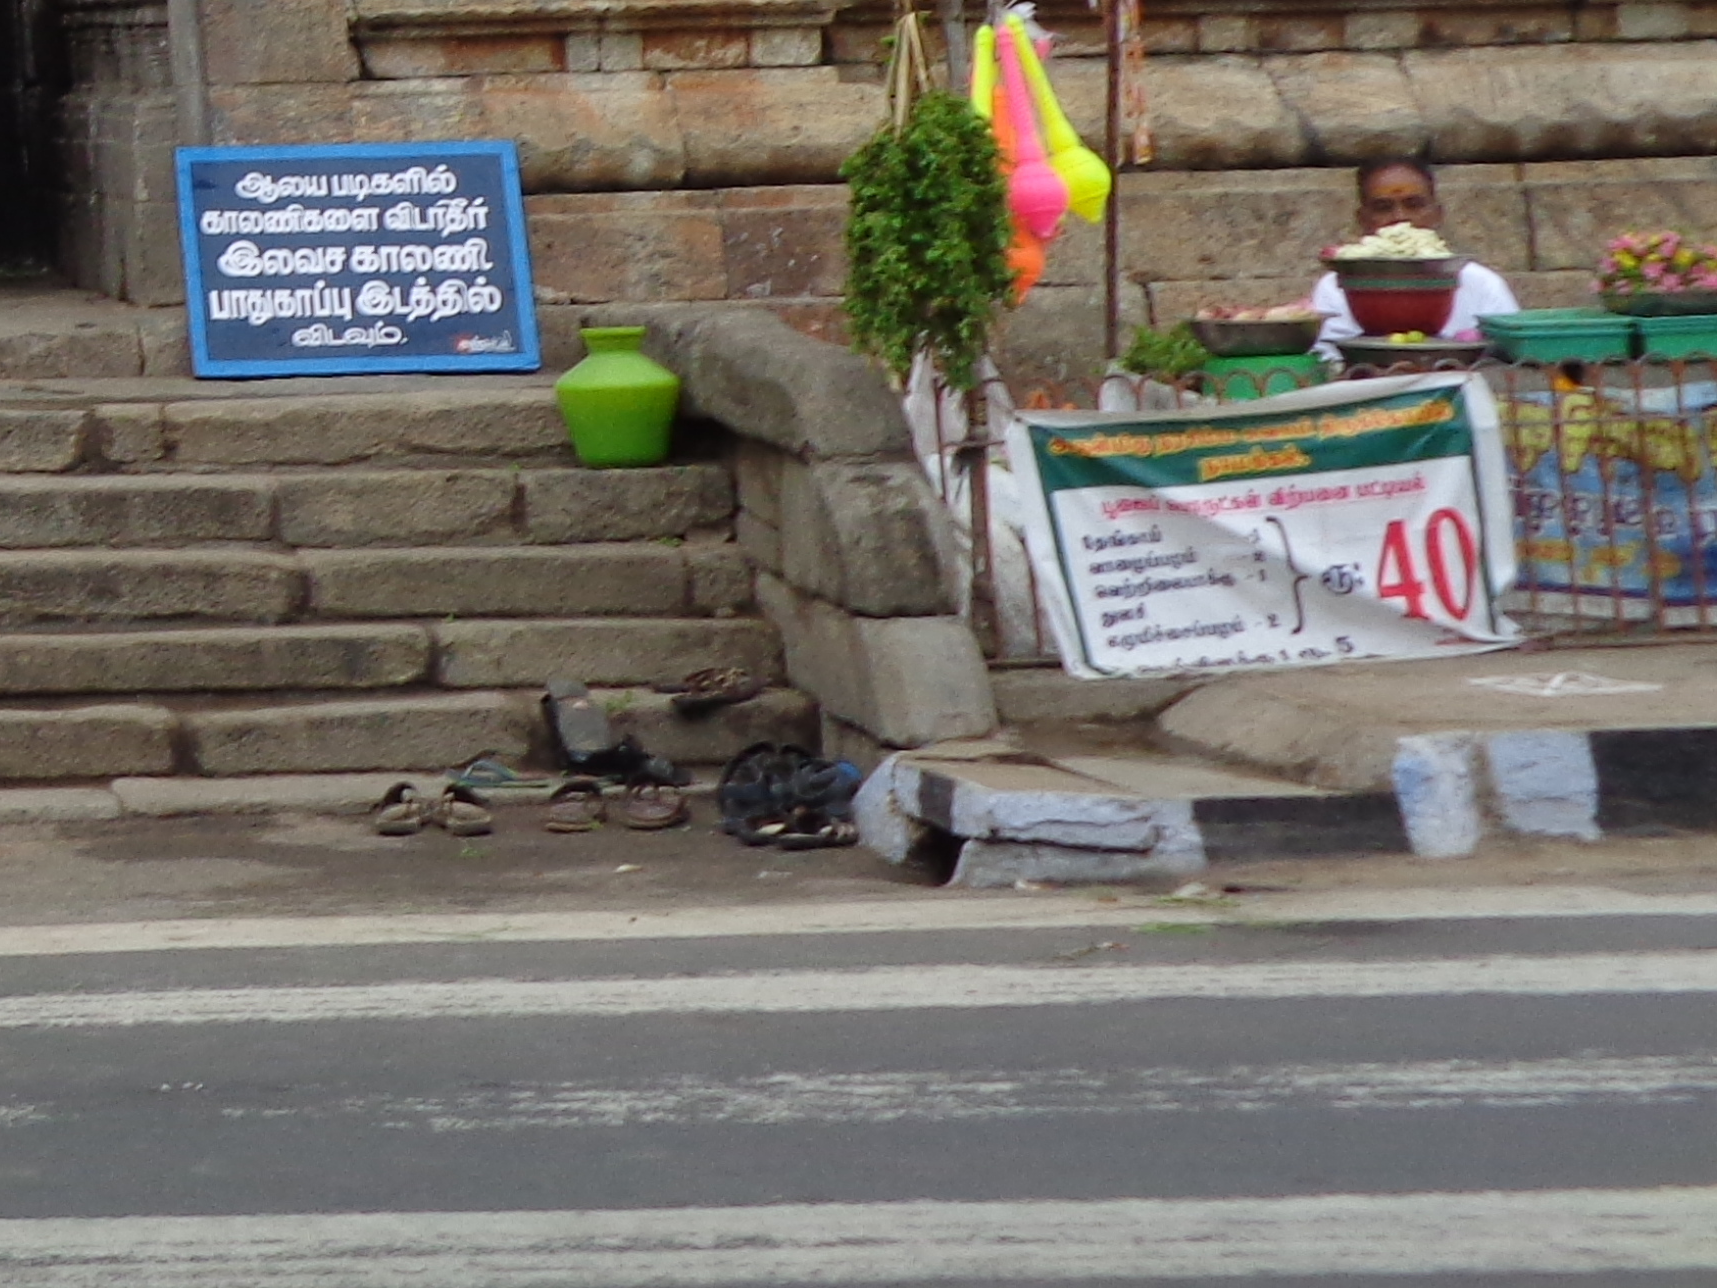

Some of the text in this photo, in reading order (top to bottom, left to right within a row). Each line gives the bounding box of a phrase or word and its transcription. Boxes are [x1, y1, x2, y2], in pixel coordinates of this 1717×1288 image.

[235, 164, 457, 204] ஆலய படிகளில்
[201, 196, 489, 237] காலணிகளை விடாதீர்
[217, 239, 346, 277] இலவச
[209, 275, 502, 326] பாதுகாப்பு இடத்தில்
[1376, 506, 1478, 622] 40
